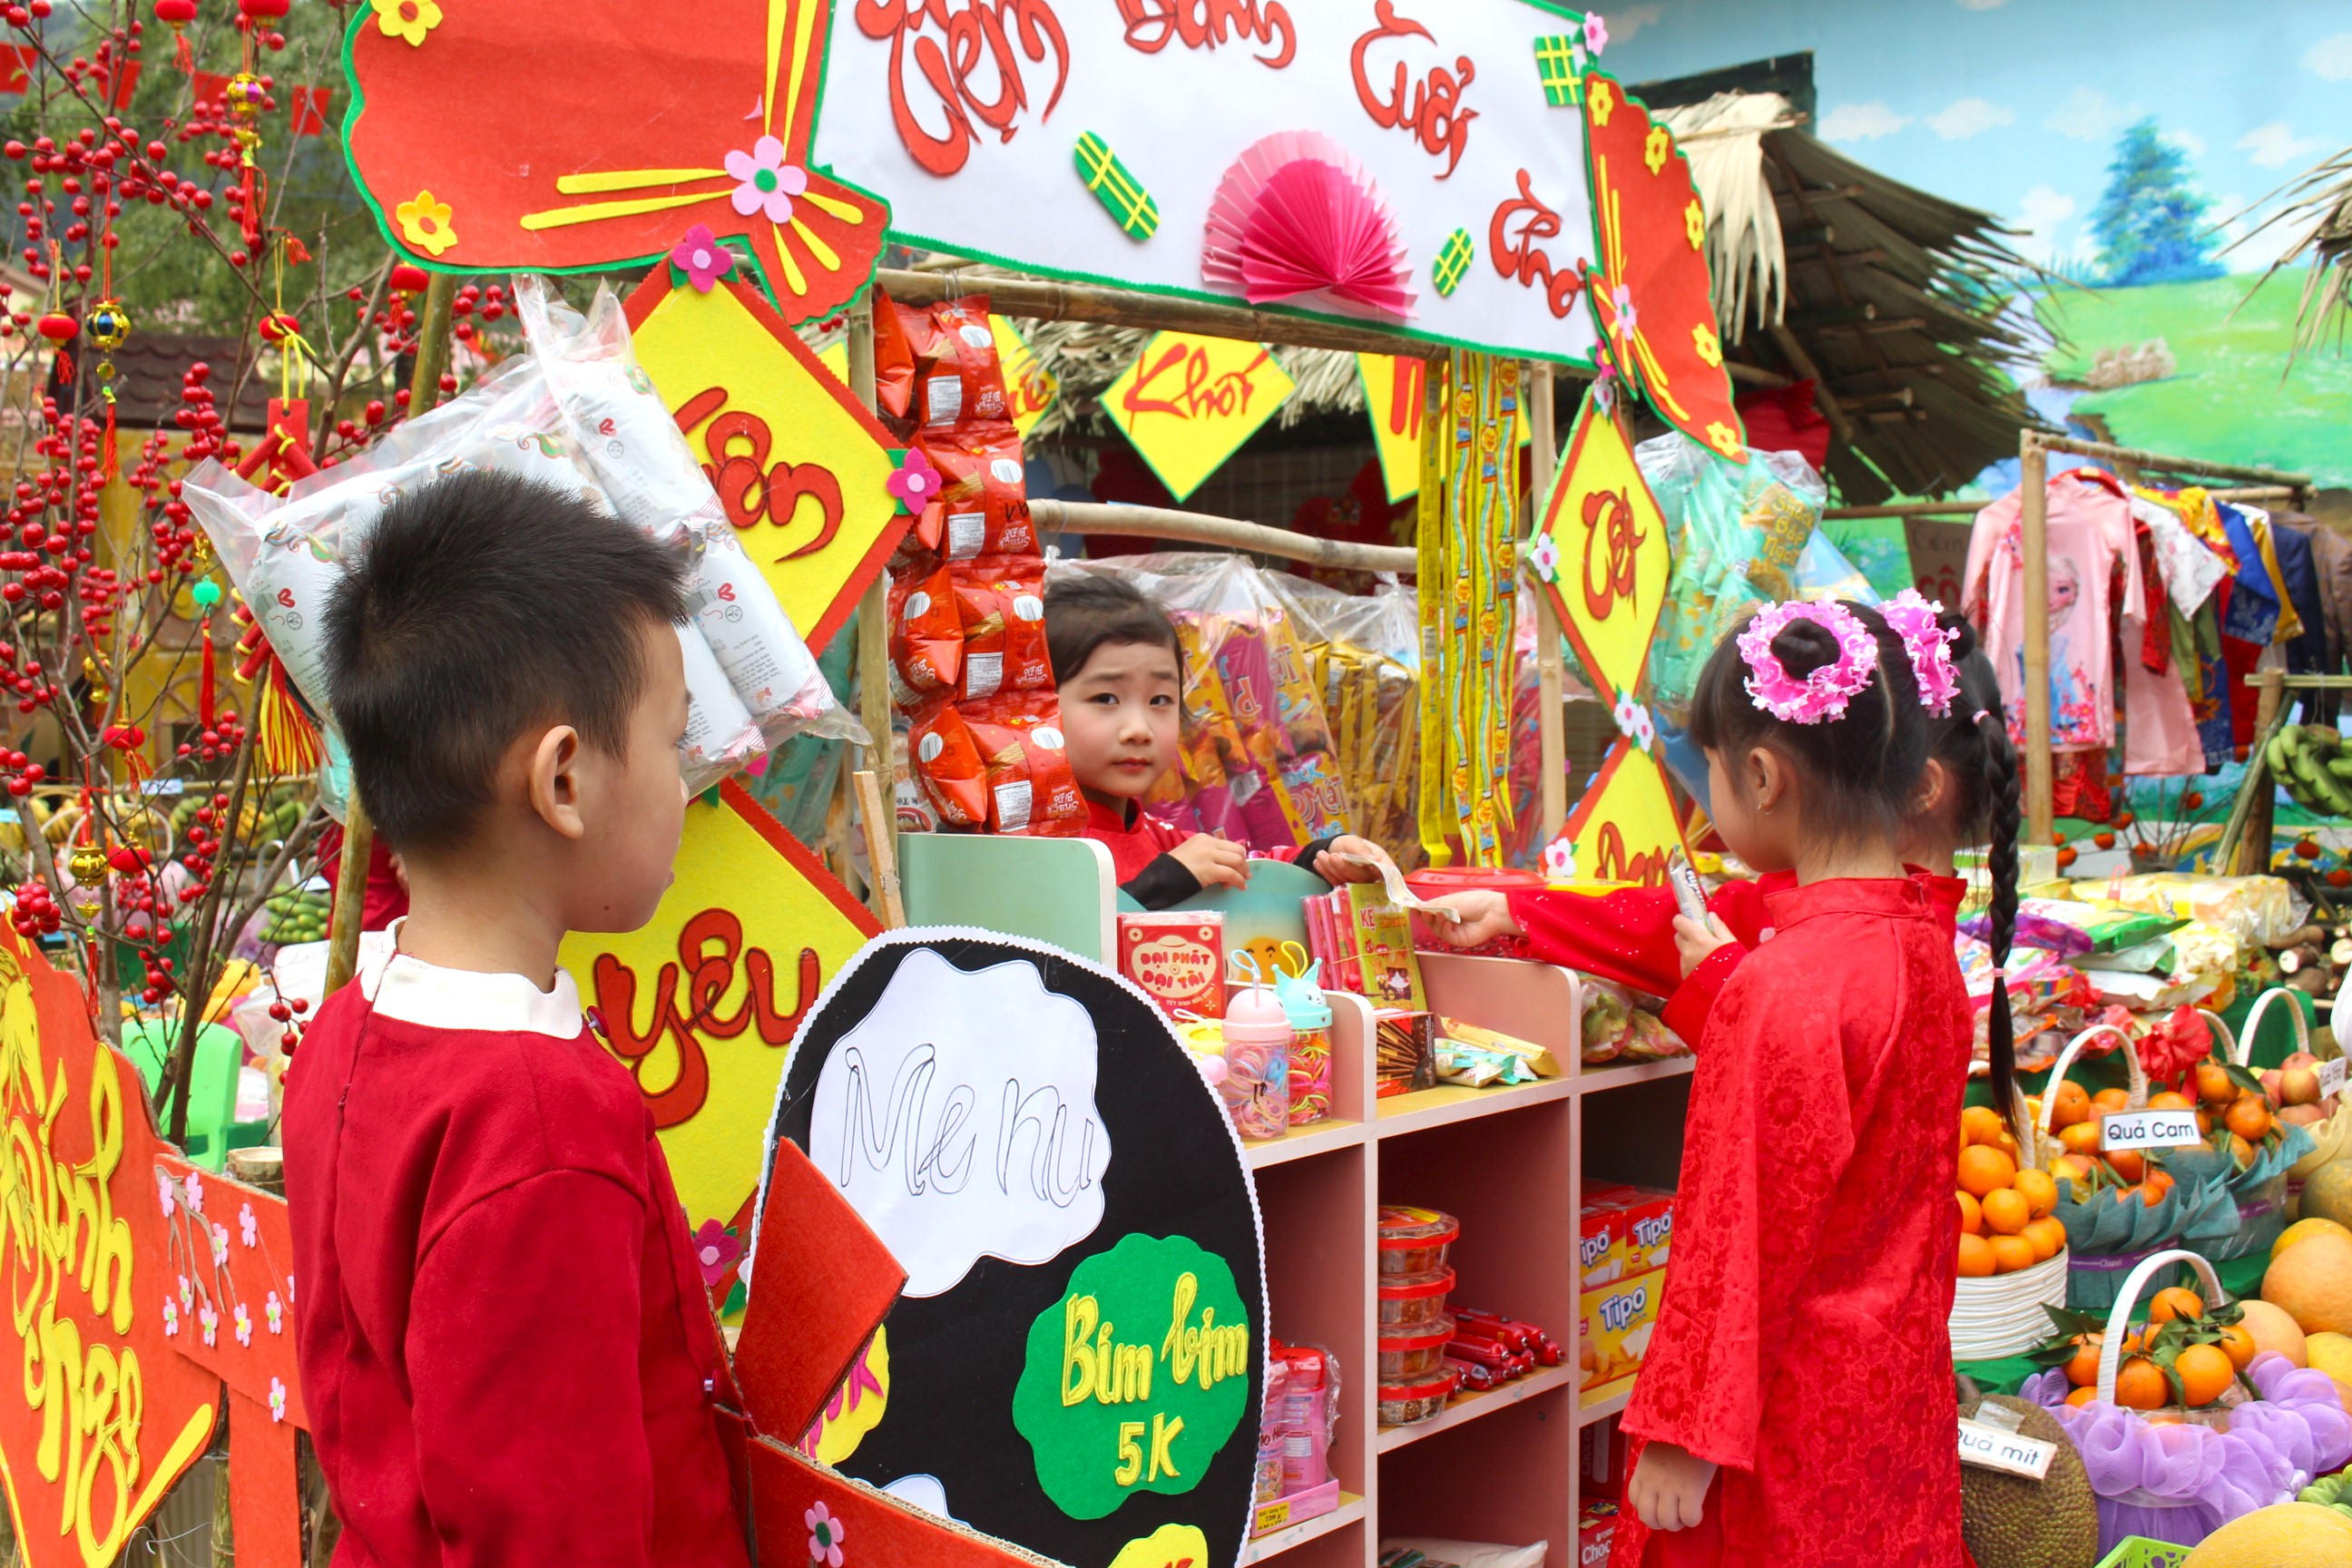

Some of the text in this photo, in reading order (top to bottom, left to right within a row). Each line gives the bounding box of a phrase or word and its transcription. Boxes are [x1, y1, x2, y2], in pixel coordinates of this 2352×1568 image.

[1489, 168, 1586, 318] Thơ
[1140, 949, 1210, 968] ĐẠI PHÁT
[1142, 969, 1173, 991] ĐẠI
[593, 907, 821, 1131] yêu
[840, 1043, 1094, 1209] Menu
[2108, 1119, 2194, 1140] Quả Cam
[1580, 1230, 1610, 1268] ipo
[1632, 1211, 1672, 1248] Tipo
[1599, 1287, 1646, 1331] Tipo
[1062, 1271, 1249, 1408] Bim bim
[1114, 1412, 1184, 1486] 5K
[2000, 1446, 2039, 1465] mít
